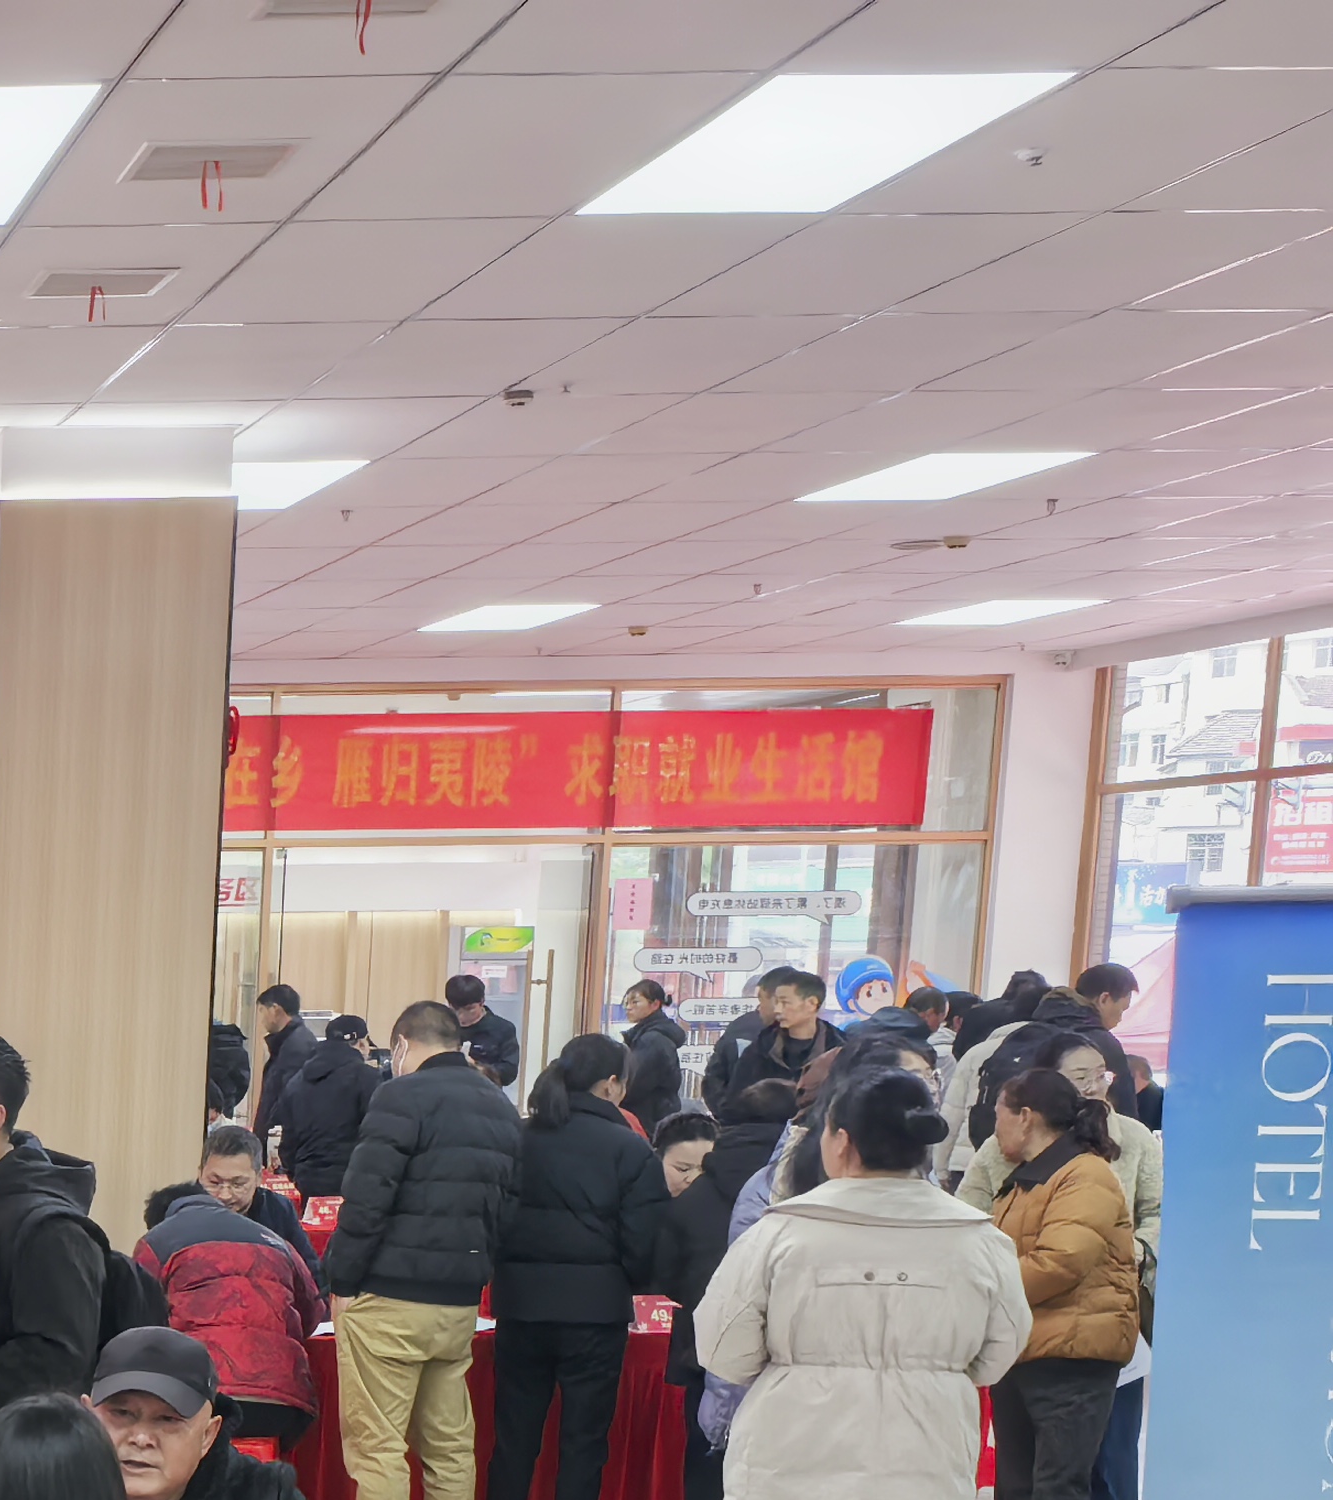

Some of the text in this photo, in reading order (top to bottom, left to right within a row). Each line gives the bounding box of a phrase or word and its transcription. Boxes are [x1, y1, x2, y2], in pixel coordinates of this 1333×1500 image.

[565, 731, 884, 807] 求职就业生活馆
[1250, 974, 1333, 1251] HOTEL
